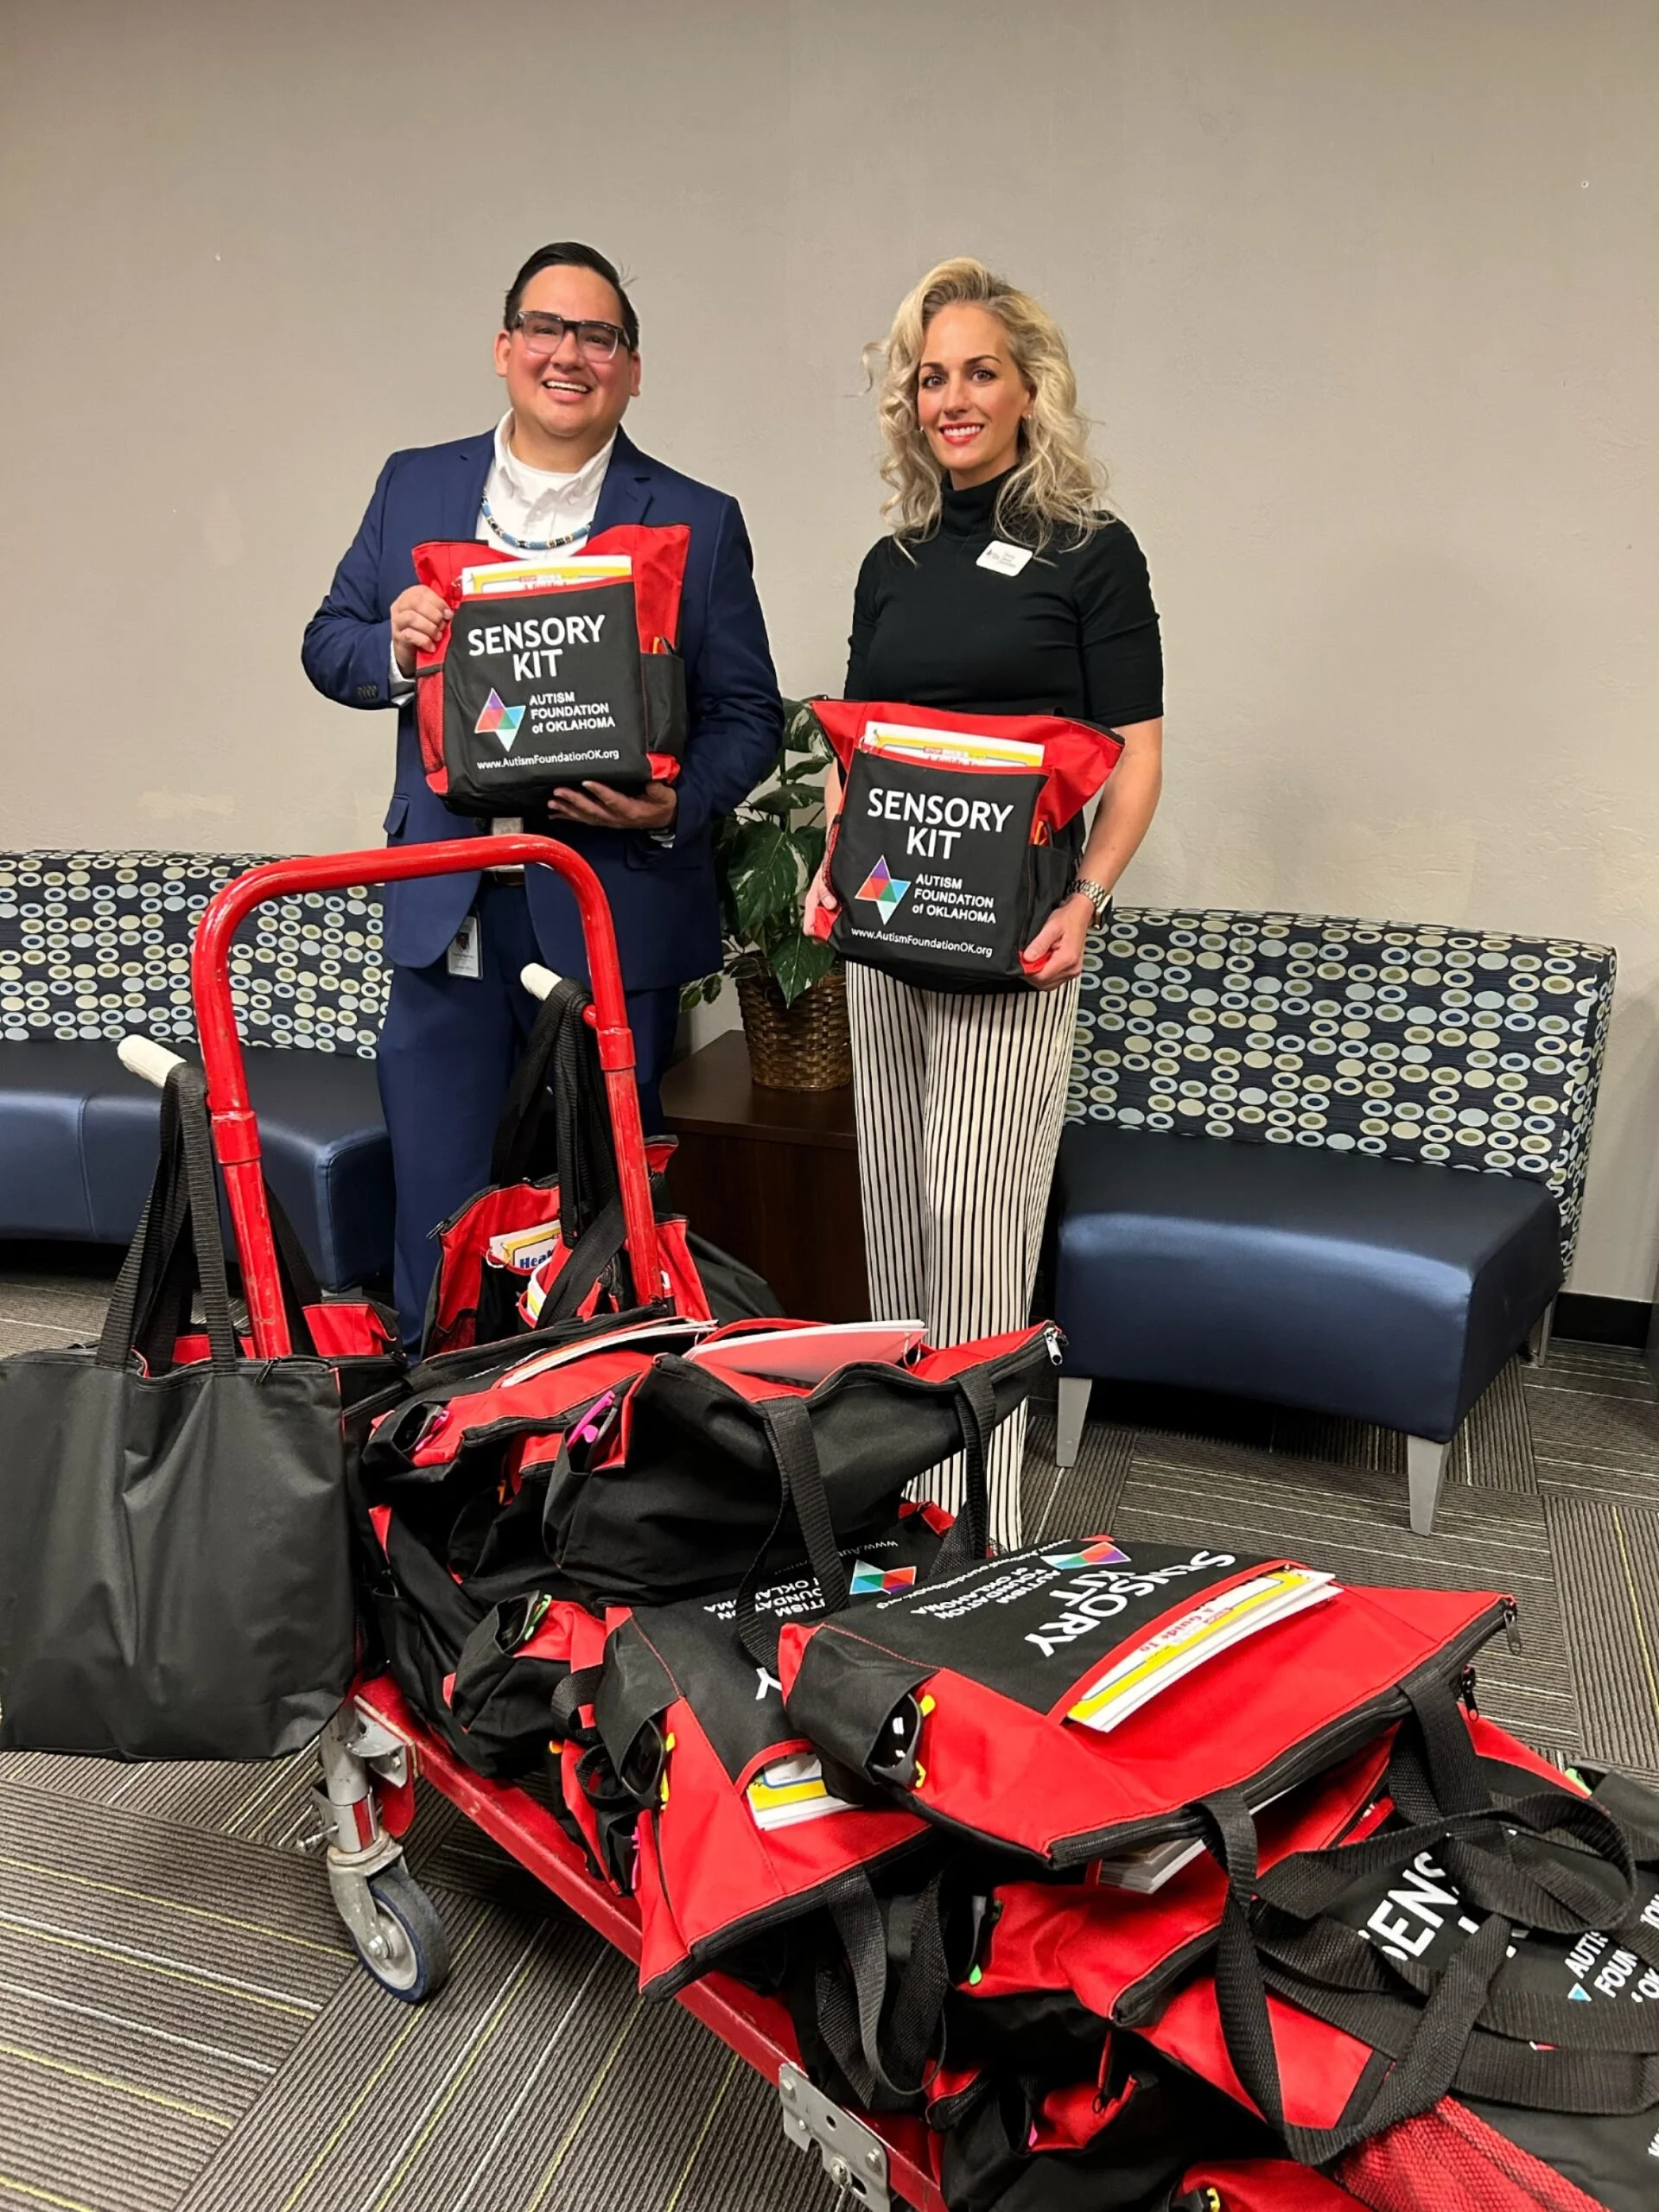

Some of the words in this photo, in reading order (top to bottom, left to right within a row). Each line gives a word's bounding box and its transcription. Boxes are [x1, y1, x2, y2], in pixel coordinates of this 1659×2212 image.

[467, 613, 605, 657] SENSORY
[512, 649, 563, 682] KIT
[529, 691, 575, 706] AUTISM
[531, 702, 610, 720] FOUNDATION
[532, 721, 545, 734] of
[547, 717, 616, 733] OKLAHOMA
[476, 749, 620, 770] www.AutismFoundationOK.org
[867, 787, 1014, 833] SENSORY
[906, 826, 962, 860] KIT
[914, 888, 995, 908] FOUNDATION
[915, 874, 963, 889] AUTISM
[912, 904, 924, 915] of
[926, 906, 996, 925] OKLAHOMA
[851, 926, 993, 958] www.AutismFoundationOK.org
[910, 1575, 1012, 1616] OKLAHOMA
[934, 1568, 1047, 1620] FOUNDATION
[995, 1569, 1061, 1605] AUTISM
[1049, 1570, 1136, 1607] KIT
[1024, 1550, 1236, 1658] SENSORY
